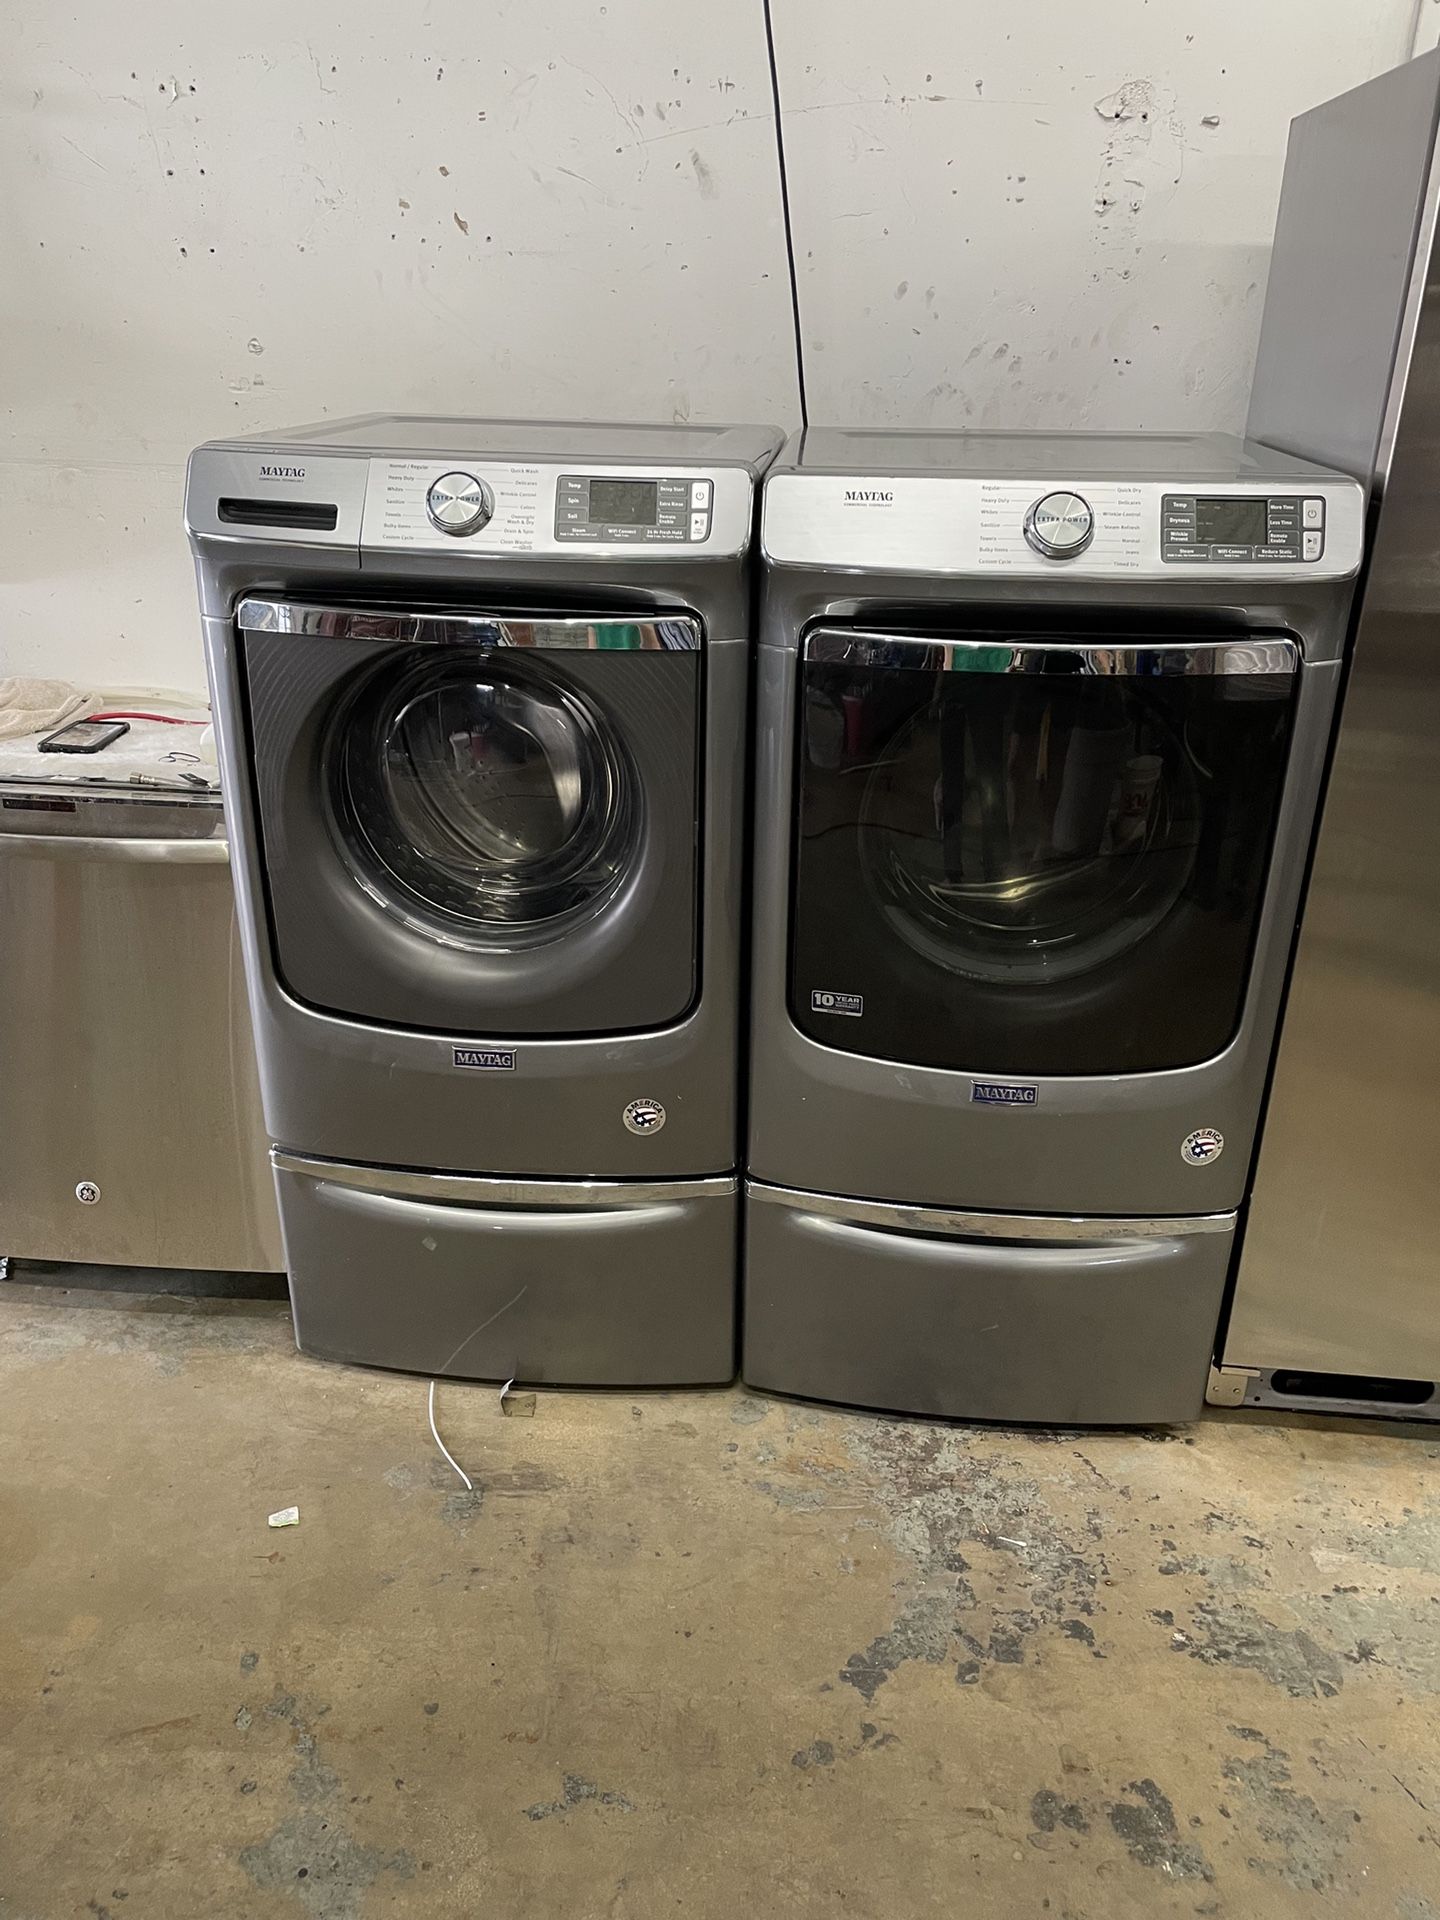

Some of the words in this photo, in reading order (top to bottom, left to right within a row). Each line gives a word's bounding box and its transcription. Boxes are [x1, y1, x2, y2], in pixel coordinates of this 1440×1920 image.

[260, 466, 306, 478] MAYTAG
[568, 482, 582, 490] Temp
[844, 491, 894, 502] MAYTAG
[1173, 501, 1188, 510] Temp
[815, 993, 835, 1006] 10
[835, 995, 861, 1003] YEAR
[456, 1052, 512, 1067] MAYTAG
[975, 1086, 1035, 1101] MAYTAG
[626, 1099, 663, 1114] AMERICA
